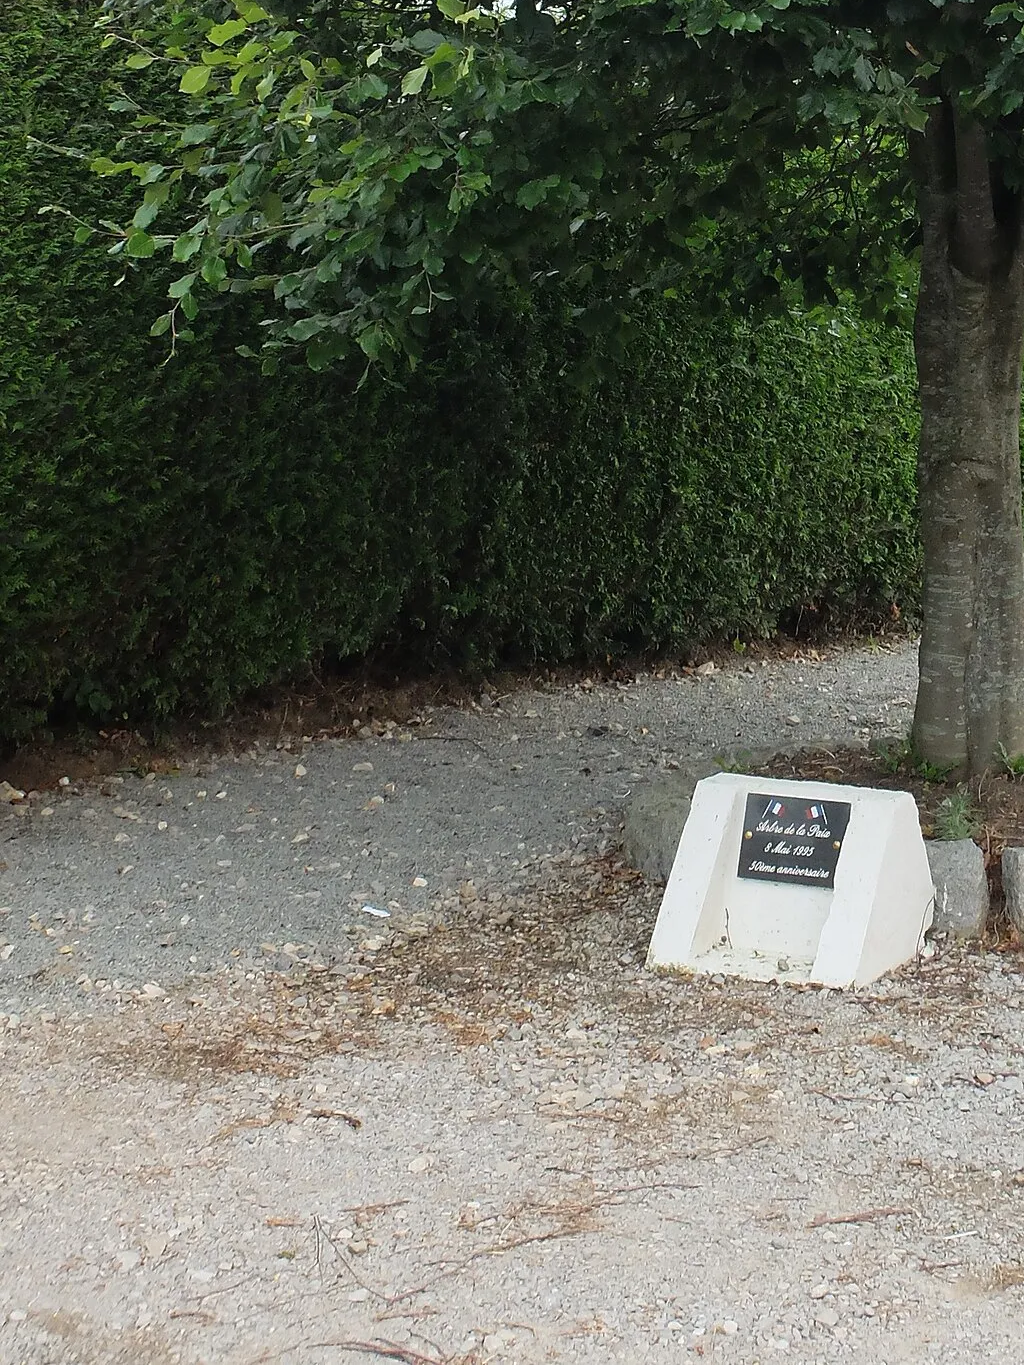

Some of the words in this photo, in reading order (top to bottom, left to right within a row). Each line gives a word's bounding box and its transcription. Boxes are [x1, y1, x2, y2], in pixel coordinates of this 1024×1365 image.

[756, 819, 783, 834] Arbre
[784, 823, 795, 835] de
[795, 824, 806, 836] la
[807, 824, 831, 838] Paix
[764, 842, 772, 853] 8
[771, 841, 791, 854] Mai
[793, 845, 815, 857] 1995
[777, 865, 830, 878] anniversaire
